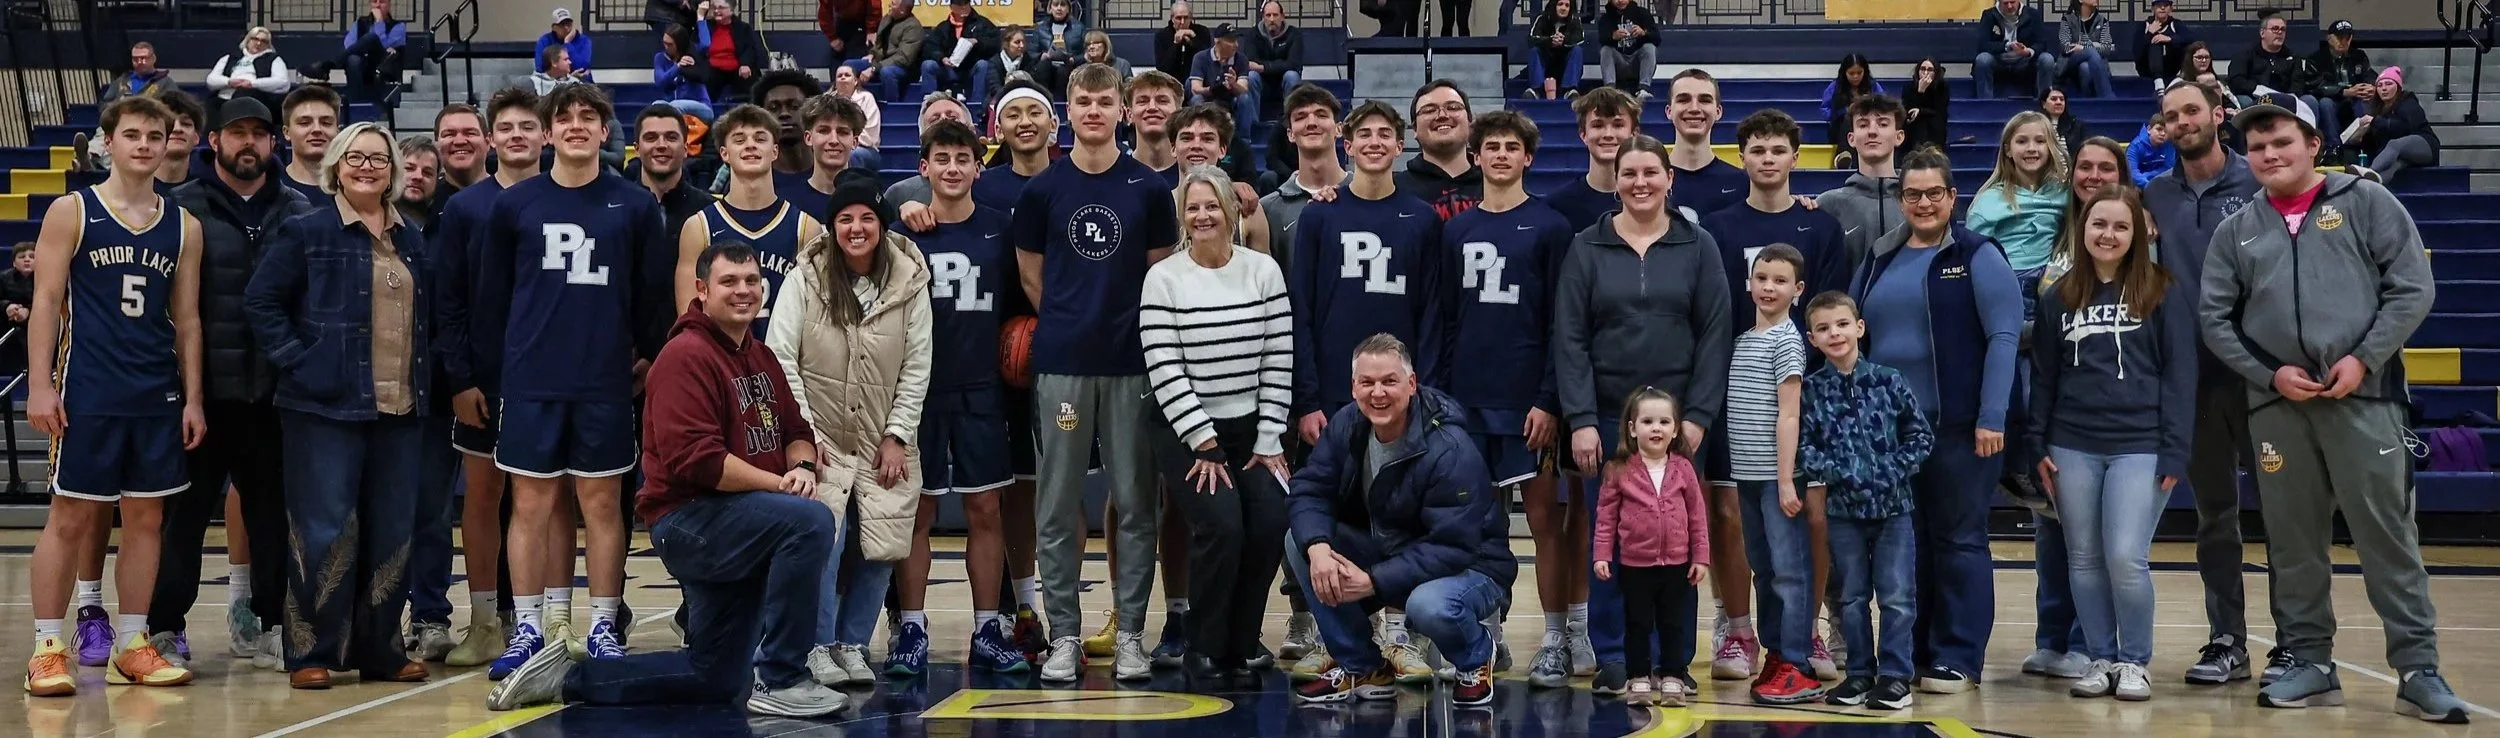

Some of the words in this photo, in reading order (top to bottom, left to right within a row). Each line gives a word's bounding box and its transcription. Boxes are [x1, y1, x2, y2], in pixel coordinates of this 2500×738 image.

[1085, 221, 1106, 243] PL
[89, 246, 134, 269] PRIOR
[141, 248, 175, 278] LAKE
[542, 222, 609, 286] PL
[760, 250, 795, 276] LAKE
[1082, 247, 1109, 257] LAKERS
[1340, 230, 1407, 295] PL
[928, 251, 994, 312] PL
[1462, 241, 1521, 304] PL
[121, 274, 147, 318] 5
[1060, 402, 1075, 415] PL
[2261, 441, 2276, 455] PL
